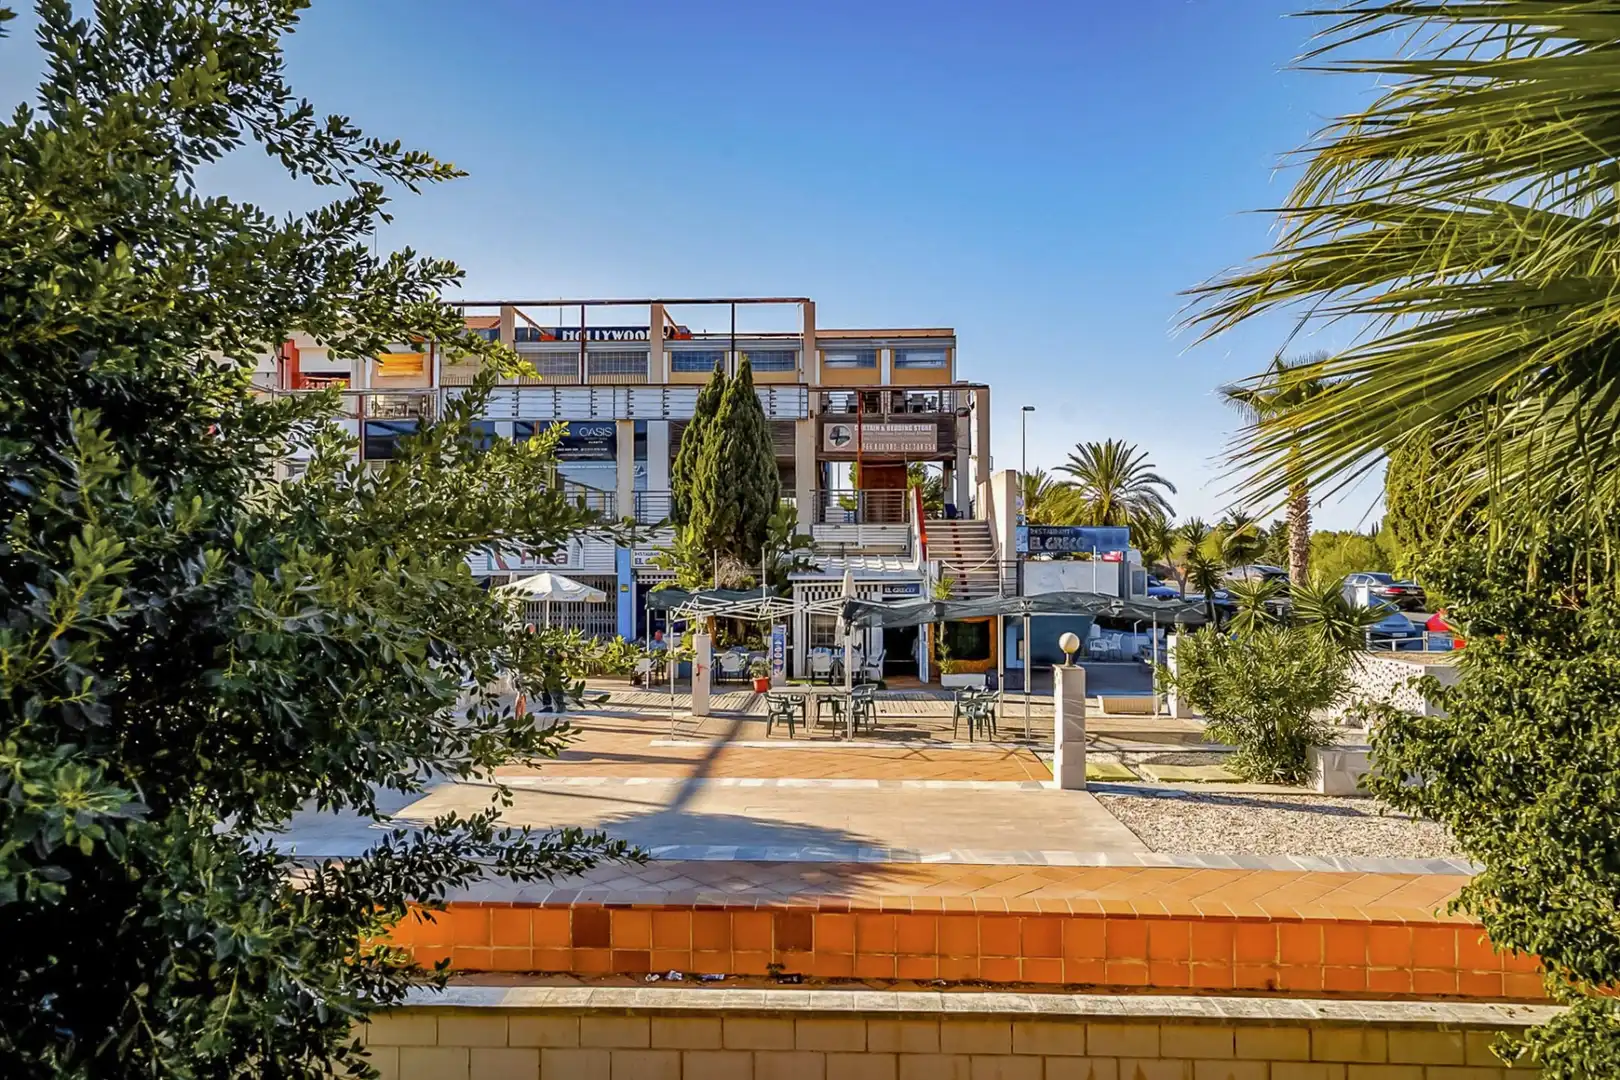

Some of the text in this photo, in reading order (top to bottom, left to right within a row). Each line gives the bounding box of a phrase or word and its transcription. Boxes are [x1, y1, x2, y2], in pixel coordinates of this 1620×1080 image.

[579, 427, 613, 437] OASIS
[1030, 536, 1086, 550] EL GRECO
[634, 557, 644, 565] EL
